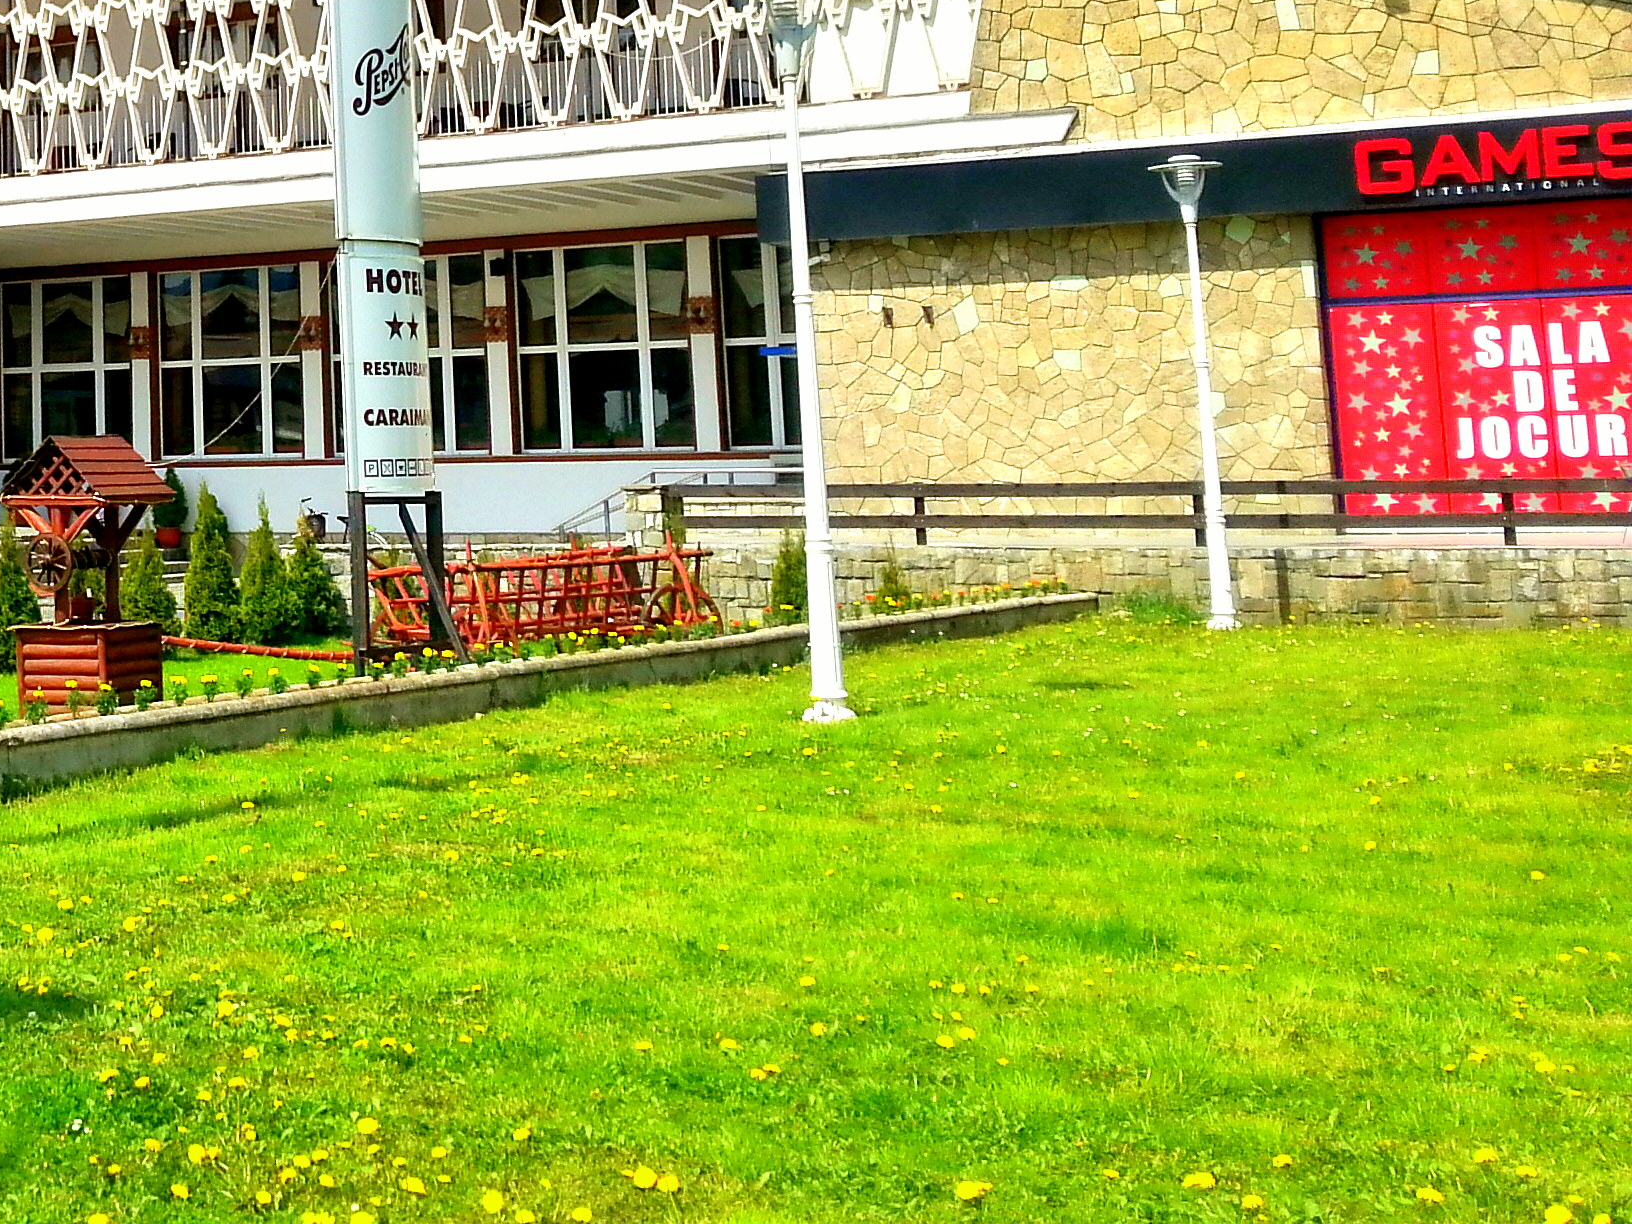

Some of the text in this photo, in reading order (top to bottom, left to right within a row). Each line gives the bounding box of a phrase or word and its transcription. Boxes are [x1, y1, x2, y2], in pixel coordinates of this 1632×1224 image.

[1353, 122, 1632, 196] GAMES
[1414, 177, 1600, 197] INTERNATIONAL
[365, 268, 423, 296] HOTEL
[1473, 321, 1611, 369] SALA
[1512, 368, 1579, 413] DE
[1456, 413, 1629, 460] JOCUR
